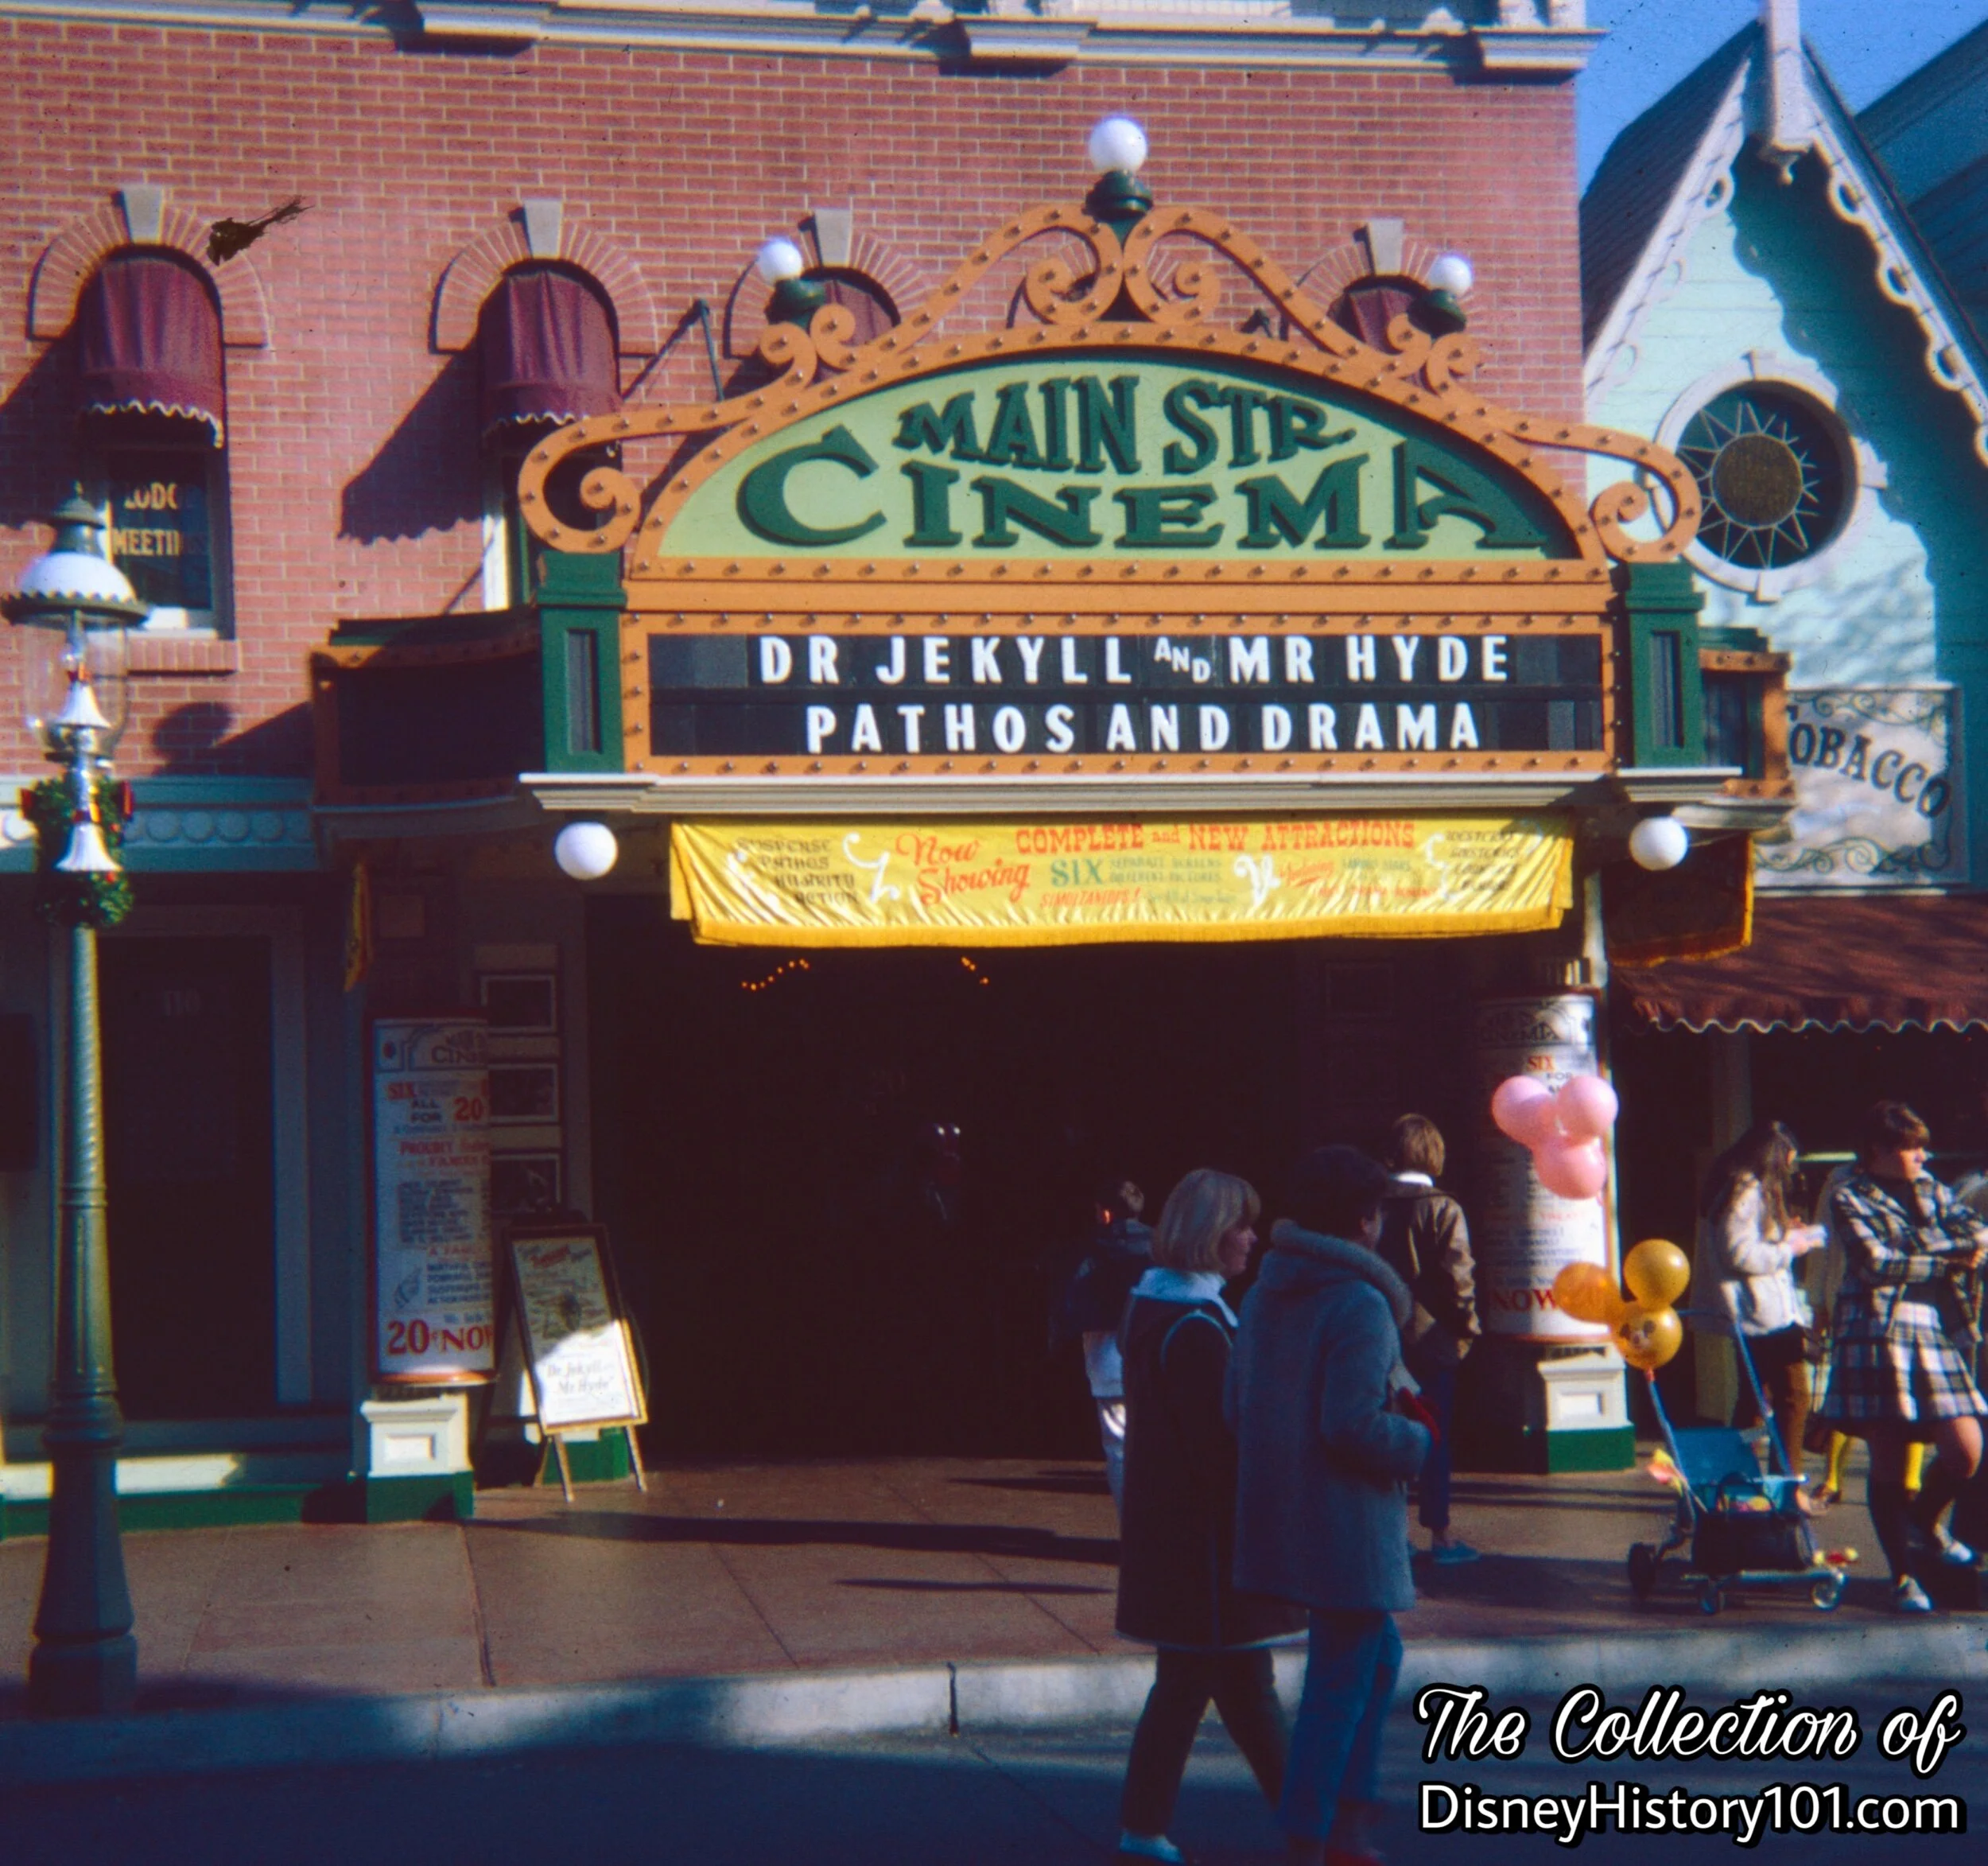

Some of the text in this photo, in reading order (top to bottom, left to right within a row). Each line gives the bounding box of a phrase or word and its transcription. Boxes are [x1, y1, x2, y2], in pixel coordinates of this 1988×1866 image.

[892, 375, 1357, 476] MAIN STR
[736, 422, 1551, 551] CINEMA
[759, 634, 1508, 685] DR JEKYLL AND MR HYDE
[806, 702, 1479, 754] PATHOS AND DRAMA
[1785, 704, 1953, 818] OBACCO
[895, 832, 980, 865] Now
[1015, 820, 1415, 854] COMPLETE and NEW ATTRACTIONS
[917, 857, 1031, 906] Showing
[1050, 858, 1104, 887] SIX
[1527, 1055, 1555, 1071] SIX
